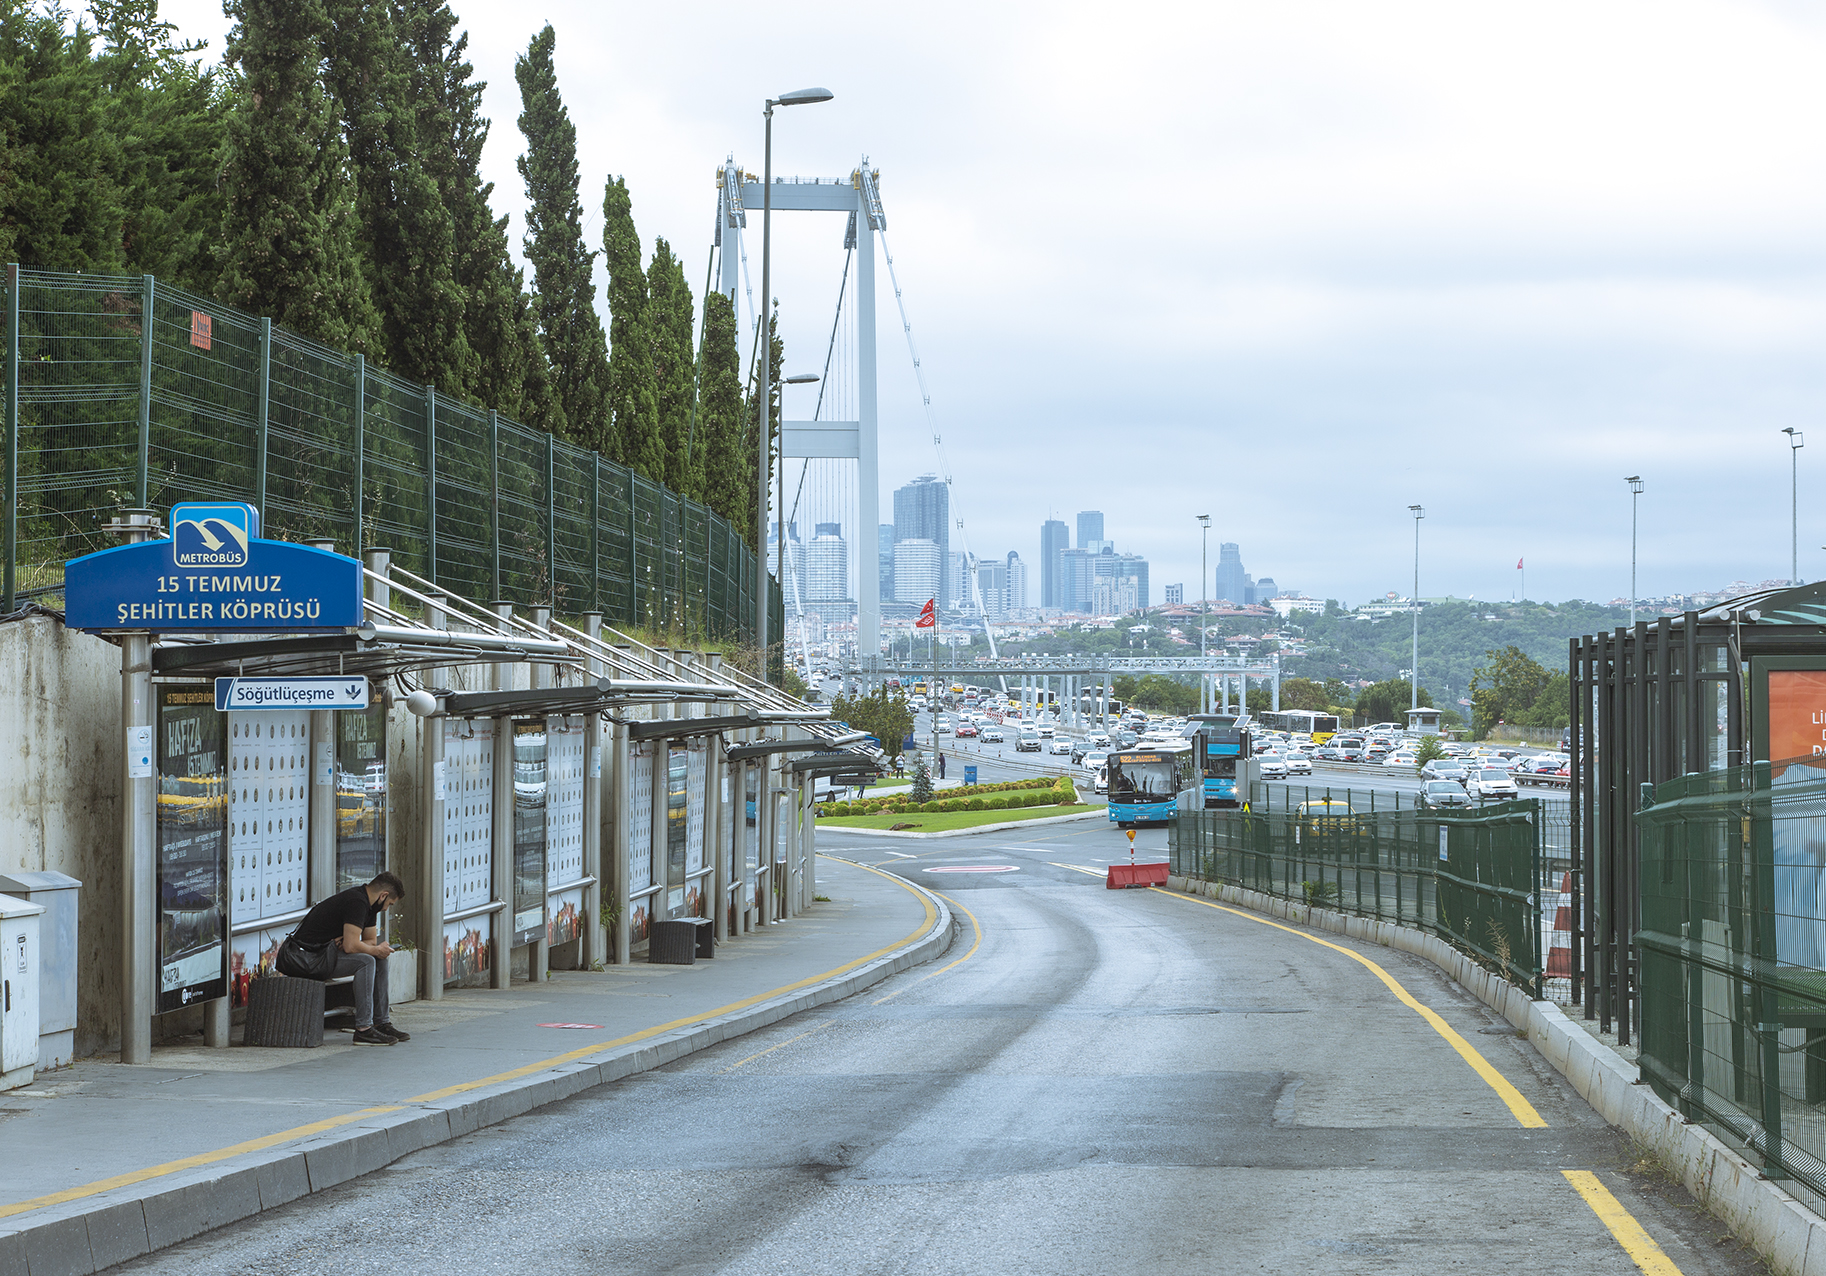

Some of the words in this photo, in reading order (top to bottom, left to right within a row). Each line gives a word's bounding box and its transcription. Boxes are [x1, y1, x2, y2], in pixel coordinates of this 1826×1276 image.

[180, 551, 241, 563] METROBÜS
[157, 576, 180, 592] 15
[186, 575, 282, 592] TEMMUZ
[117, 599, 214, 624] ŞEHİTLER
[221, 598, 321, 619] KÖPRÜSÜ
[237, 686, 335, 705] Söğütlüçeşme
[1812, 744, 1826, 757] D
